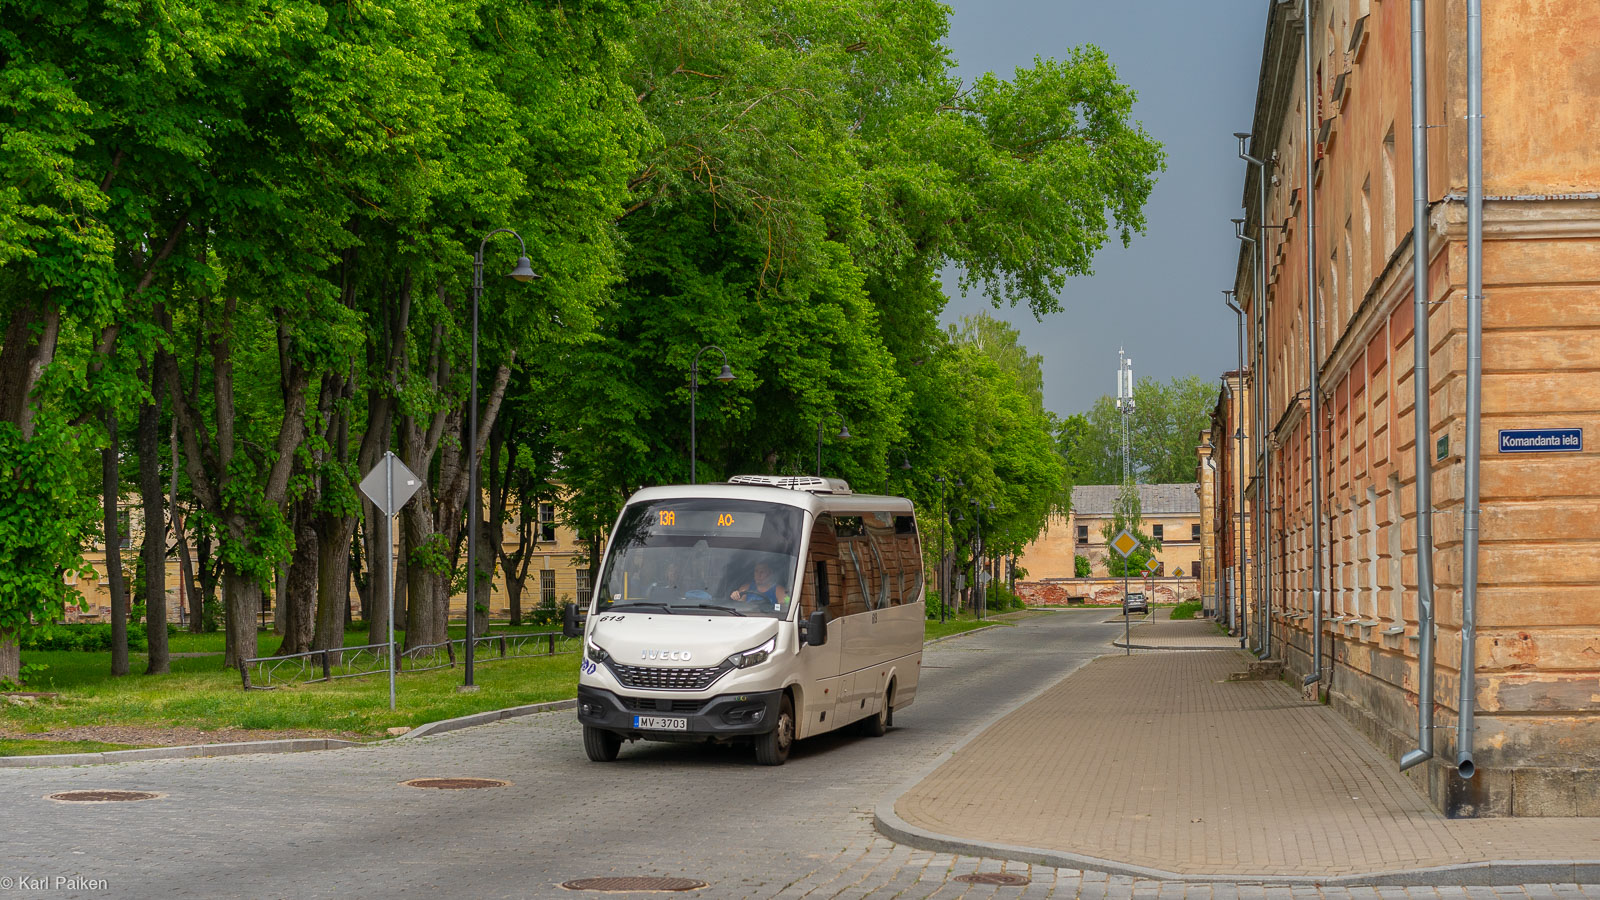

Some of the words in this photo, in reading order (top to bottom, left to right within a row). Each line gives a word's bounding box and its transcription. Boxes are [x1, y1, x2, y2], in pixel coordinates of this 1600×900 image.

[1502, 435, 1560, 447] Komandanta
[1562, 434, 1579, 446] iela
[659, 510, 676, 526] 13A
[641, 648, 692, 661] IVECO
[640, 717, 686, 729] MV-3703
